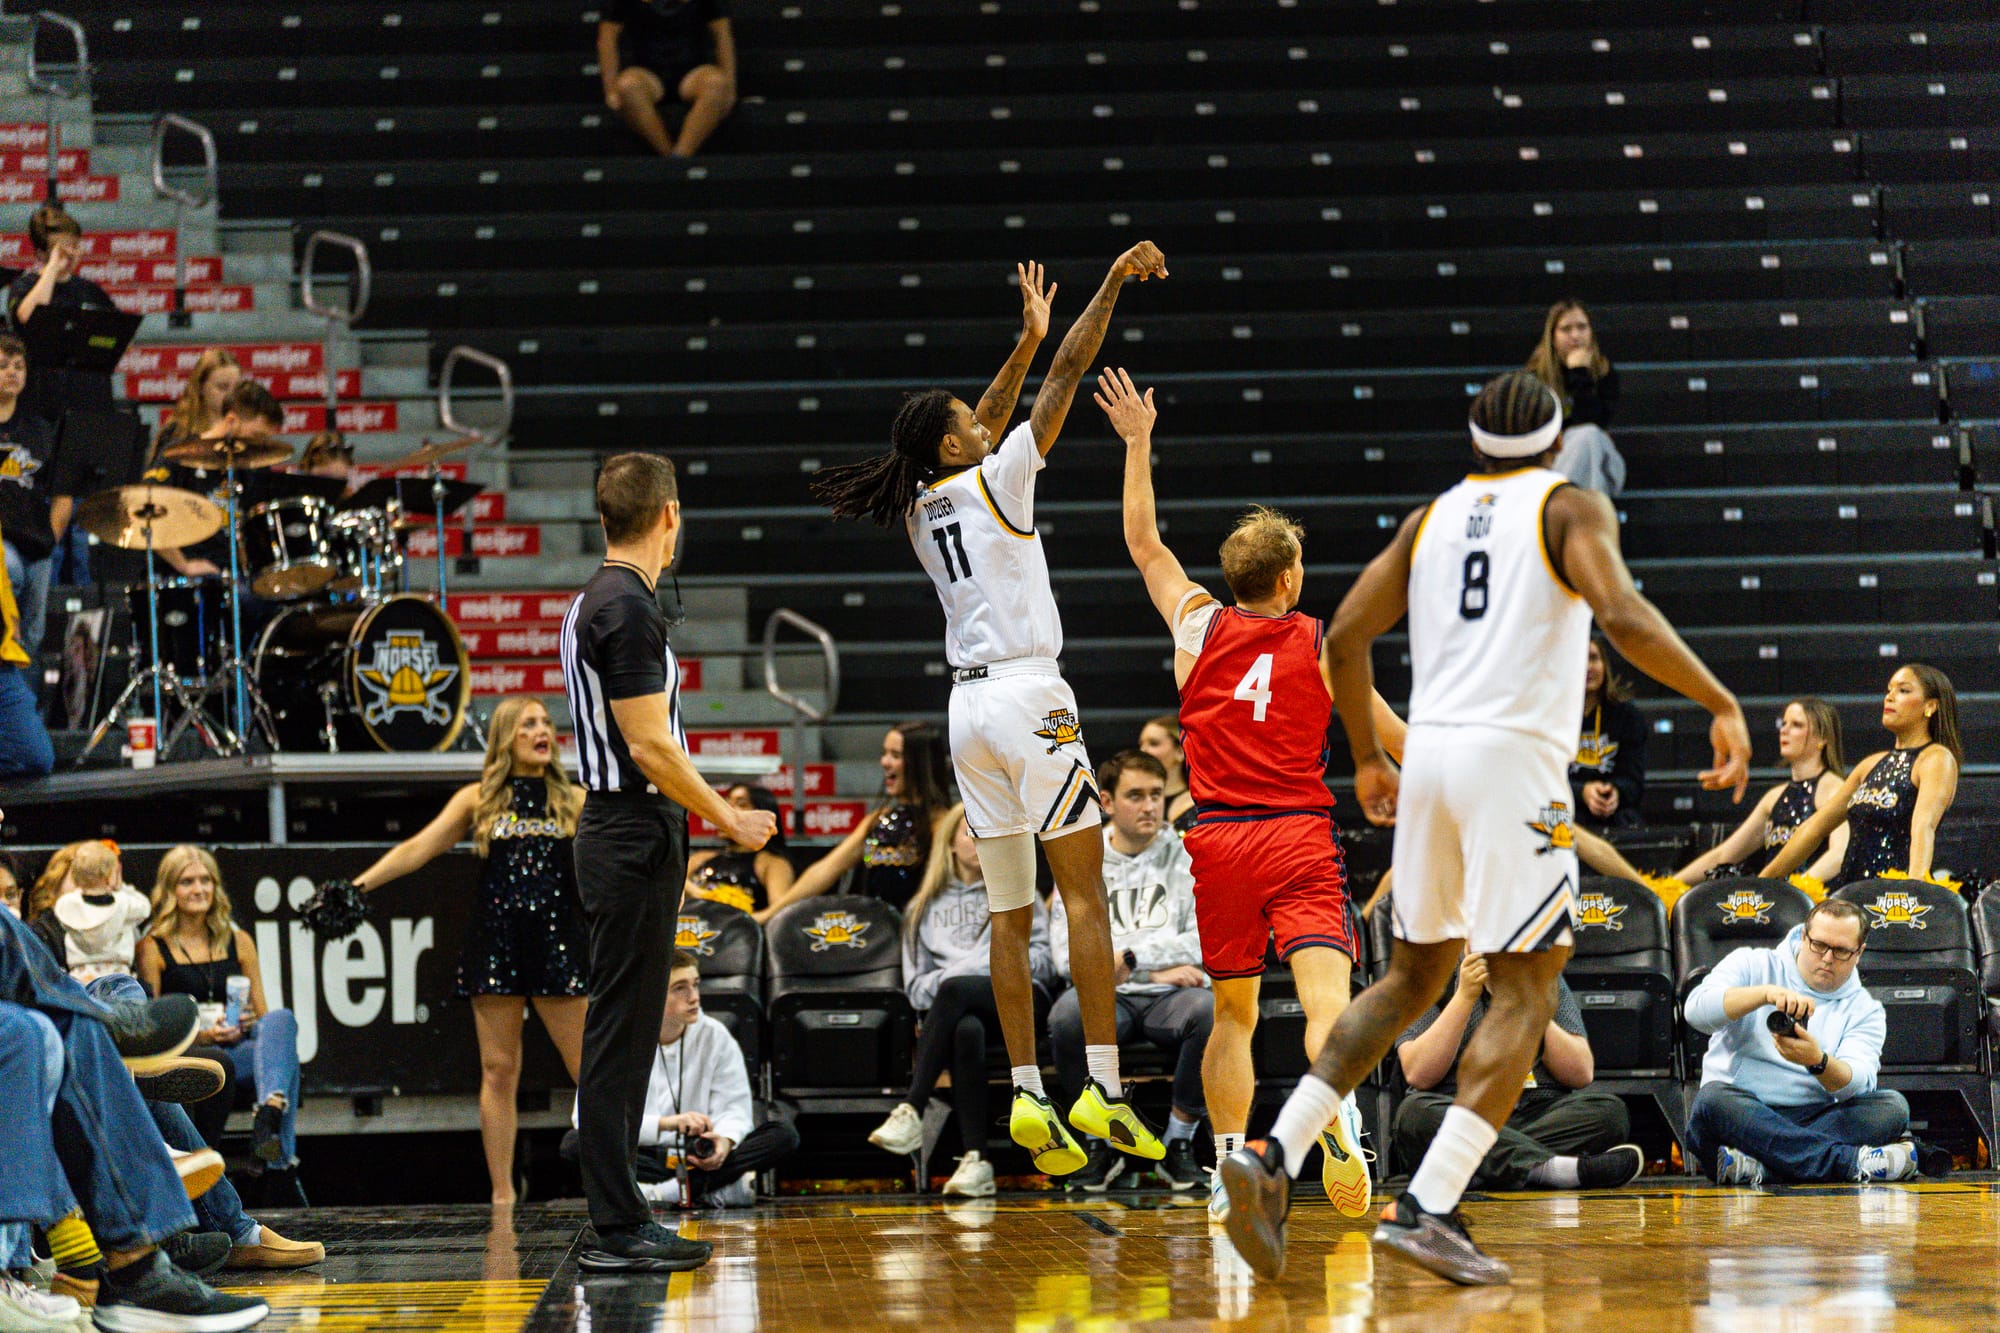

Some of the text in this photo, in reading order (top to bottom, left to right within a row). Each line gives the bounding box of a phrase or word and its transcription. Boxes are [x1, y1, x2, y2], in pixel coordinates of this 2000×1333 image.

[110, 234, 167, 257] meijer
[252, 344, 311, 373] meijer
[923, 496, 956, 522] DOZIER
[931, 521, 973, 584] 11
[1459, 550, 1490, 621] 8
[460, 592, 523, 623] meijer
[1233, 653, 1274, 722] 4
[1041, 714, 1077, 733] NORSE
[1877, 897, 1918, 914] NORSE
[254, 875, 434, 1064] ijer
